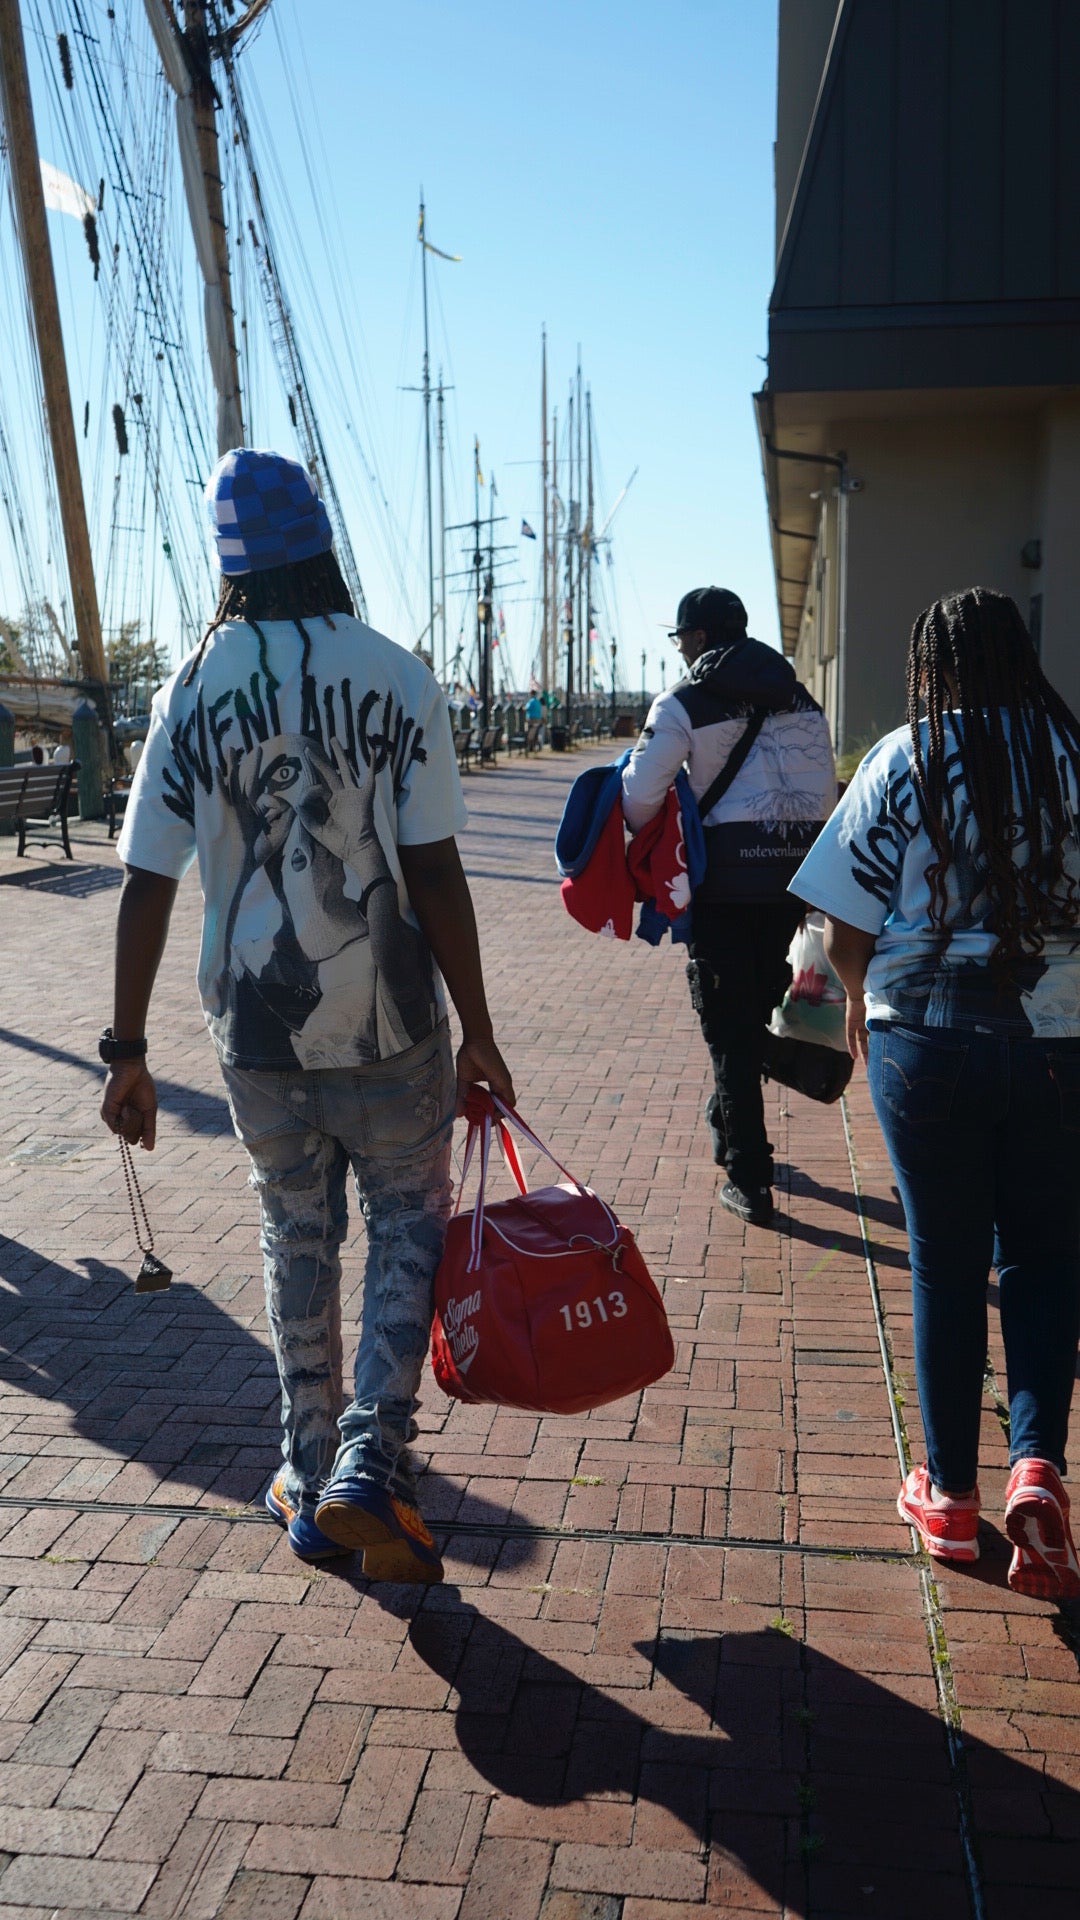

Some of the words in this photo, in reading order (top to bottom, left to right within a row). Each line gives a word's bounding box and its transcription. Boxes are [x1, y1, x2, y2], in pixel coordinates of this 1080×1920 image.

[739, 841, 813, 858] notevenlau
[444, 1290, 481, 1332] Sigma
[559, 1291, 628, 1331] 1913
